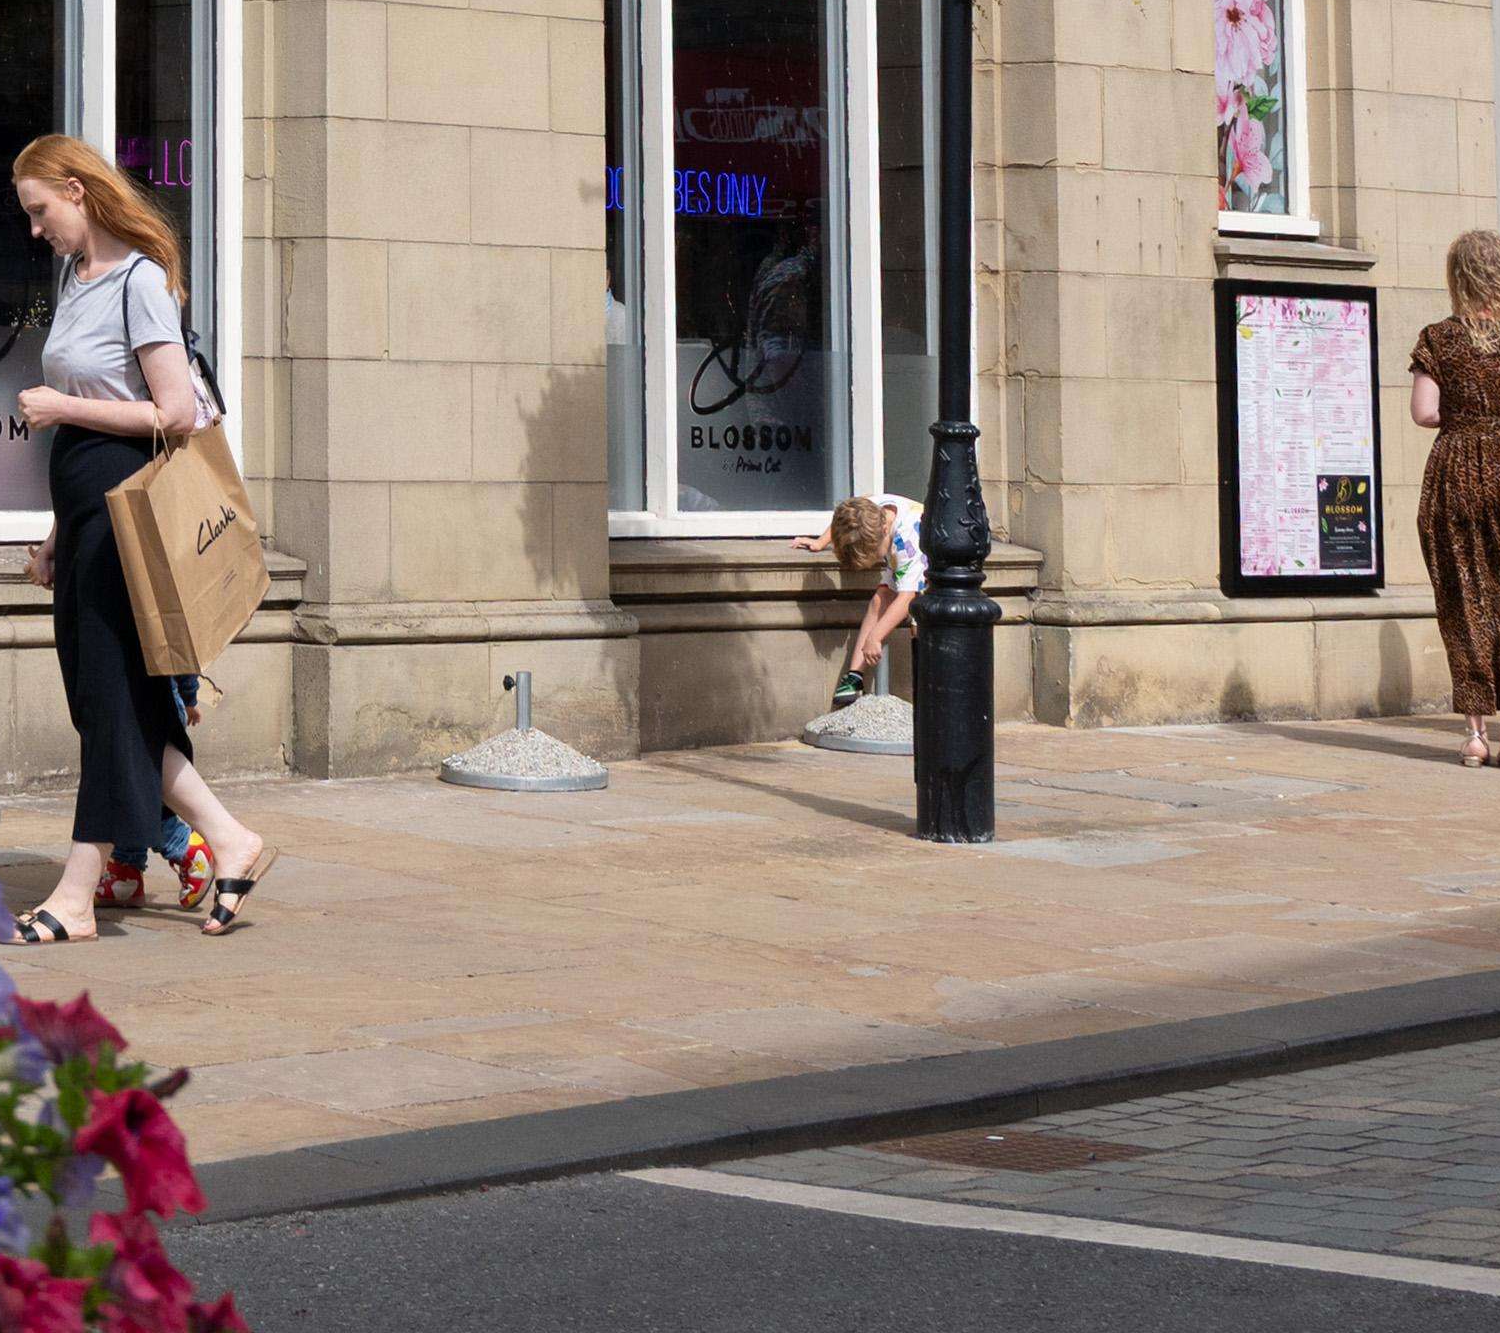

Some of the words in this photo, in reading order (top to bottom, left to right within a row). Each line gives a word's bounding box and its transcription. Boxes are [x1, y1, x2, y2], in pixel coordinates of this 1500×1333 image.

[717, 172, 767, 218] ONLY
[690, 425, 812, 452] BLOSSOM
[736, 455, 762, 474] Prime
[764, 456, 782, 474] Cut
[1325, 504, 1363, 514] BLOSSOM
[197, 505, 237, 555] Clarks
